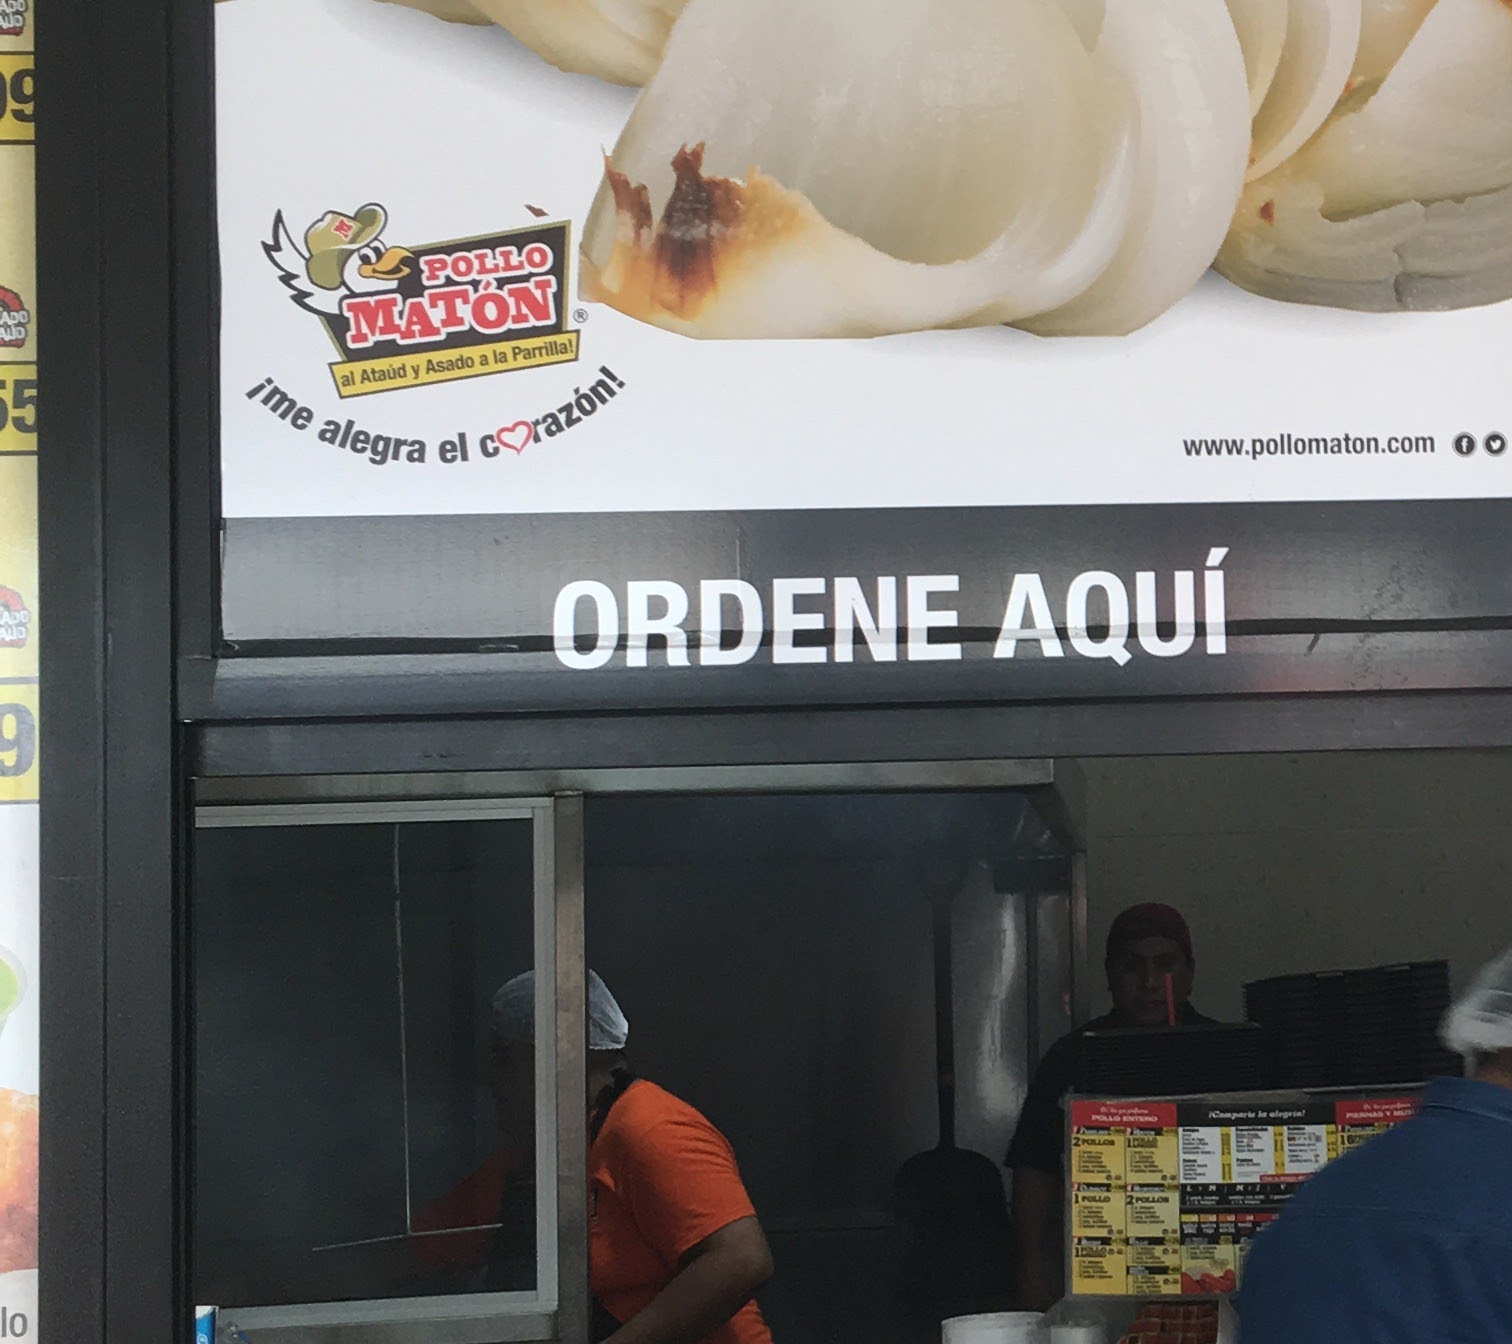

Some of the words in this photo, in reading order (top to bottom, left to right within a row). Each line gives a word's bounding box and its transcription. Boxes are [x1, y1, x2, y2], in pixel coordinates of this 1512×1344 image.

[421, 242, 553, 286] POLLO
[342, 276, 557, 349] MATÓN
[340, 368, 356, 388] al
[360, 360, 408, 385] Ataúd
[411, 364, 421, 381] y
[425, 354, 475, 376] Asado
[479, 354, 489, 368] a
[492, 348, 508, 365] la
[511, 337, 575, 364] Parrilla!
[245, 376, 315, 431] ¡me
[318, 410, 427, 466] alegra
[437, 431, 469, 464] el
[1183, 432, 1436, 460] www.pollomaton.com
[552, 573, 962, 670] ORDENE
[992, 546, 1229, 667] AQUÍ
